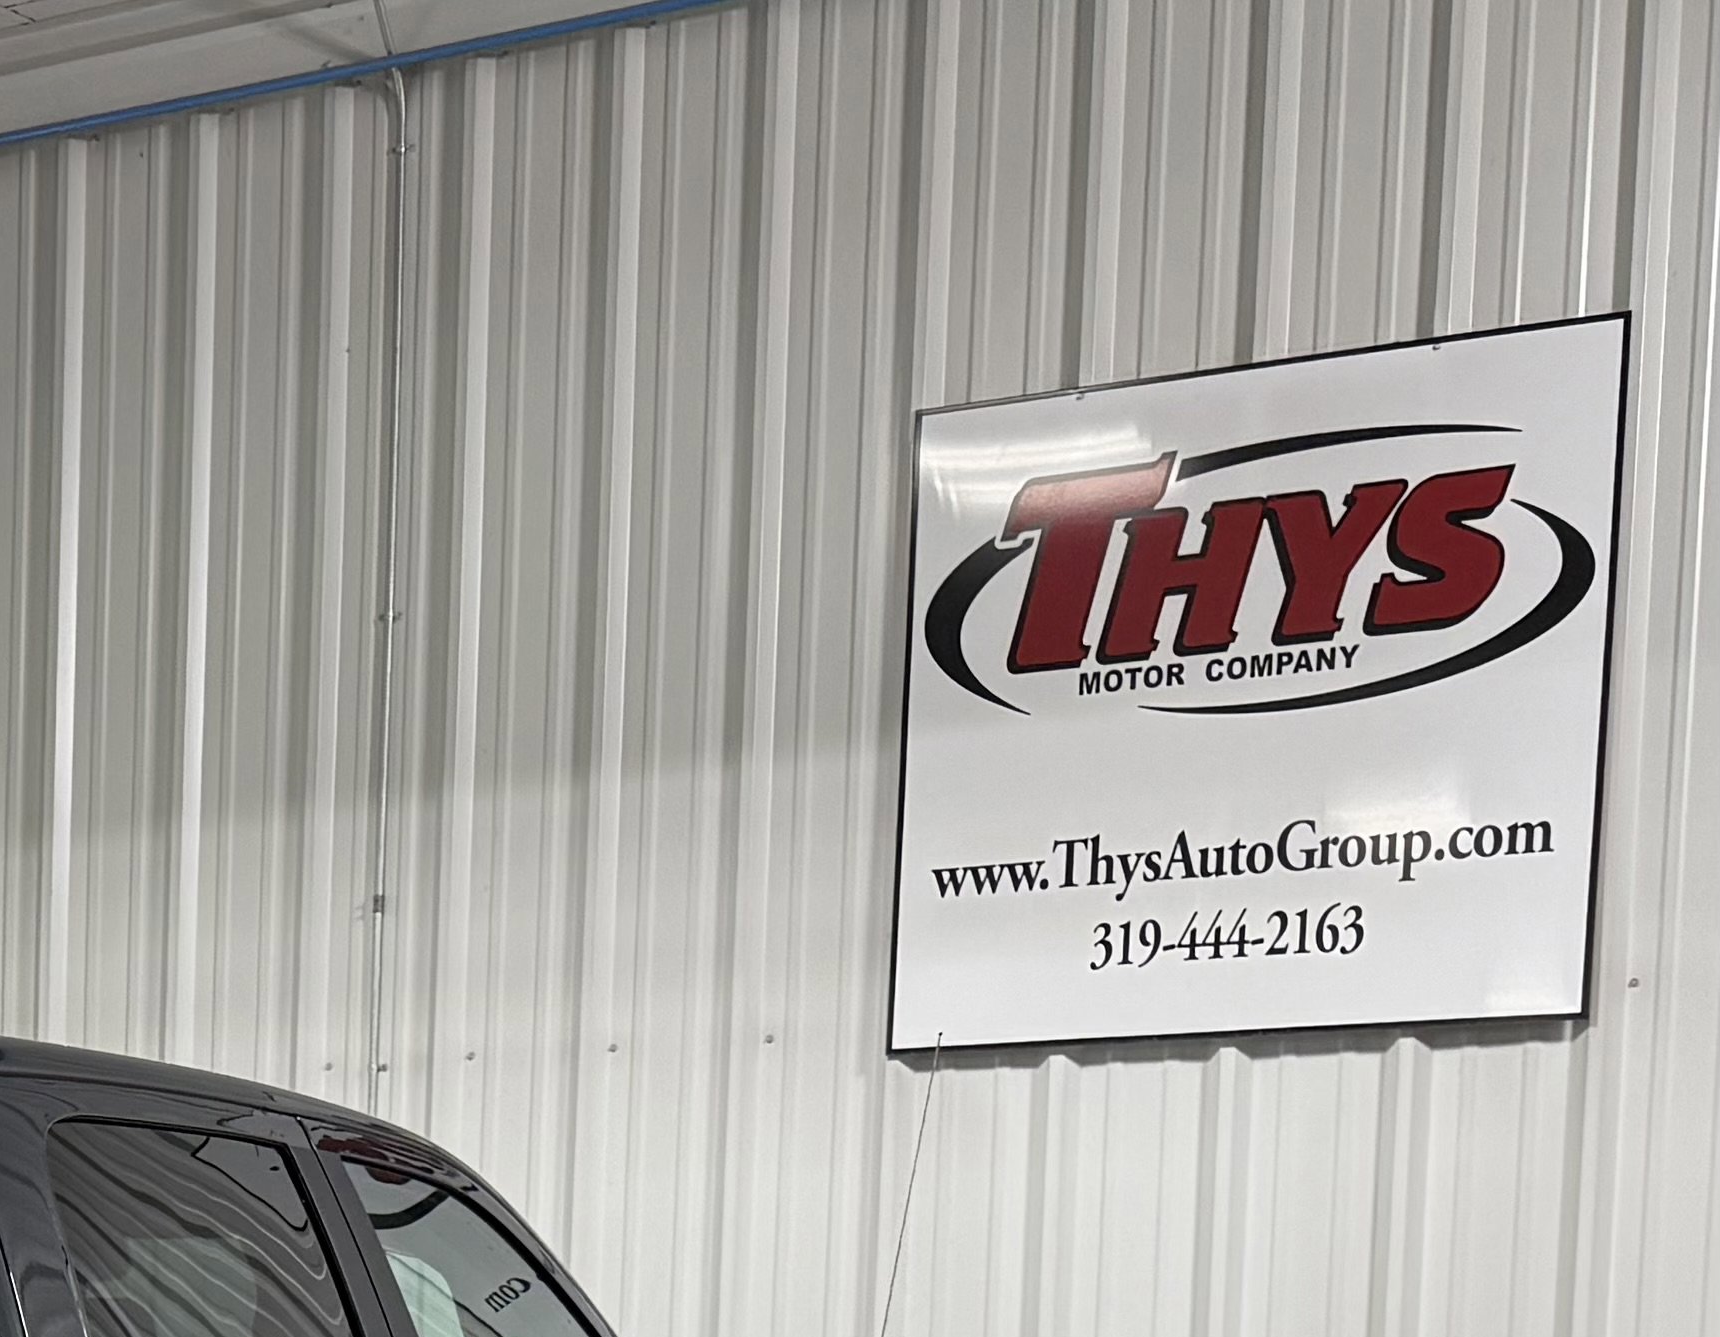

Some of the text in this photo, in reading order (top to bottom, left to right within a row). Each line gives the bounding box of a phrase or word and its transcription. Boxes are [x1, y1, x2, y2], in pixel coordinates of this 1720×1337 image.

[1000, 450, 1516, 673] THYS
[1078, 644, 1360, 697] MOTOR COMPANY
[931, 817, 1555, 901] www.ThysAutoGroup.com
[1090, 903, 1365, 971] 319-444-2163
